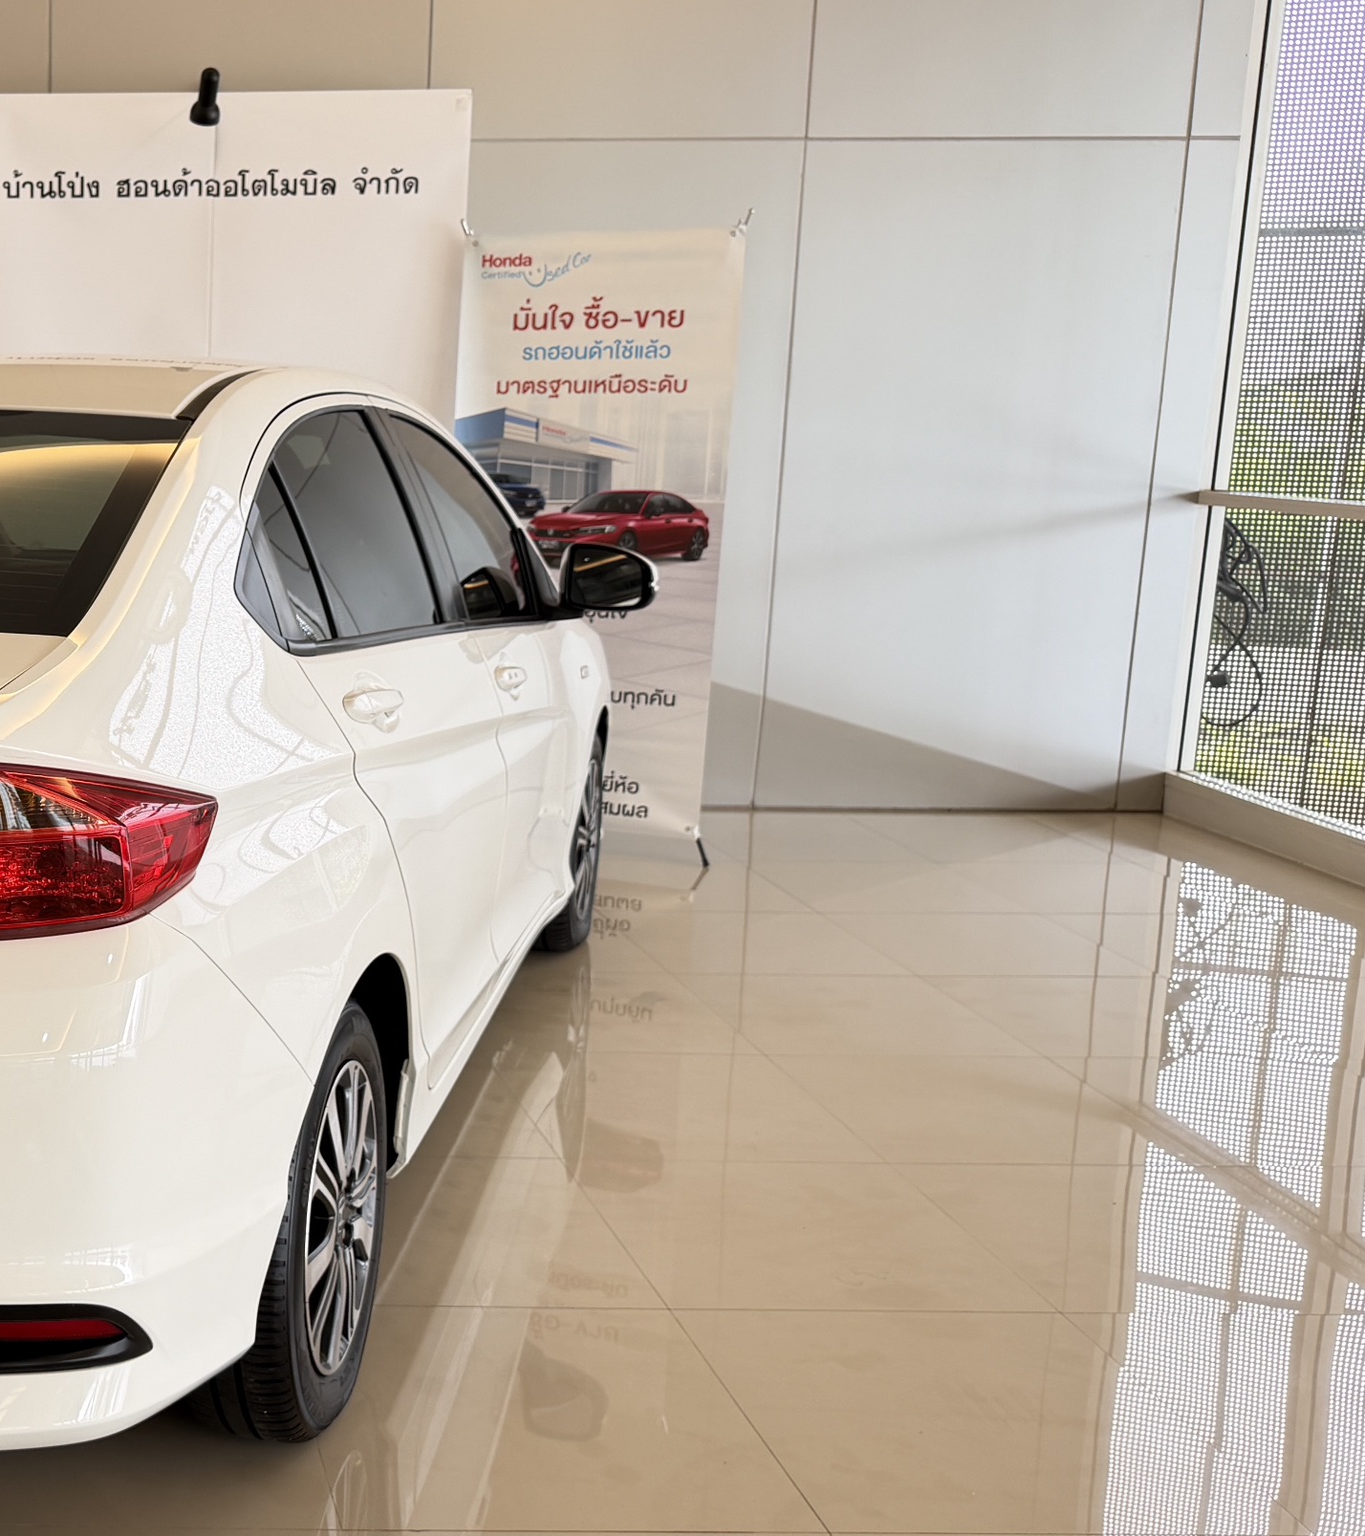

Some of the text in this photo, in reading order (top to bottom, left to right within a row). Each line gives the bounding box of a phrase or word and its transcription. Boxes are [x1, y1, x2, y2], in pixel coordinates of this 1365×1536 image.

[3, 170, 100, 199] บ้านโป่ง
[116, 168, 336, 198] ฮอนด้าออโตโมบิล
[353, 167, 418, 195] จำกัด
[482, 253, 532, 268] Honda
[481, 271, 521, 279] Certified
[512, 296, 685, 331] มั่นใจ ซื้อ-ขาย
[522, 339, 671, 361] รถฮอนด้าใช้แล้ว
[496, 373, 688, 399] มาตรฐานเหนือระดับ
